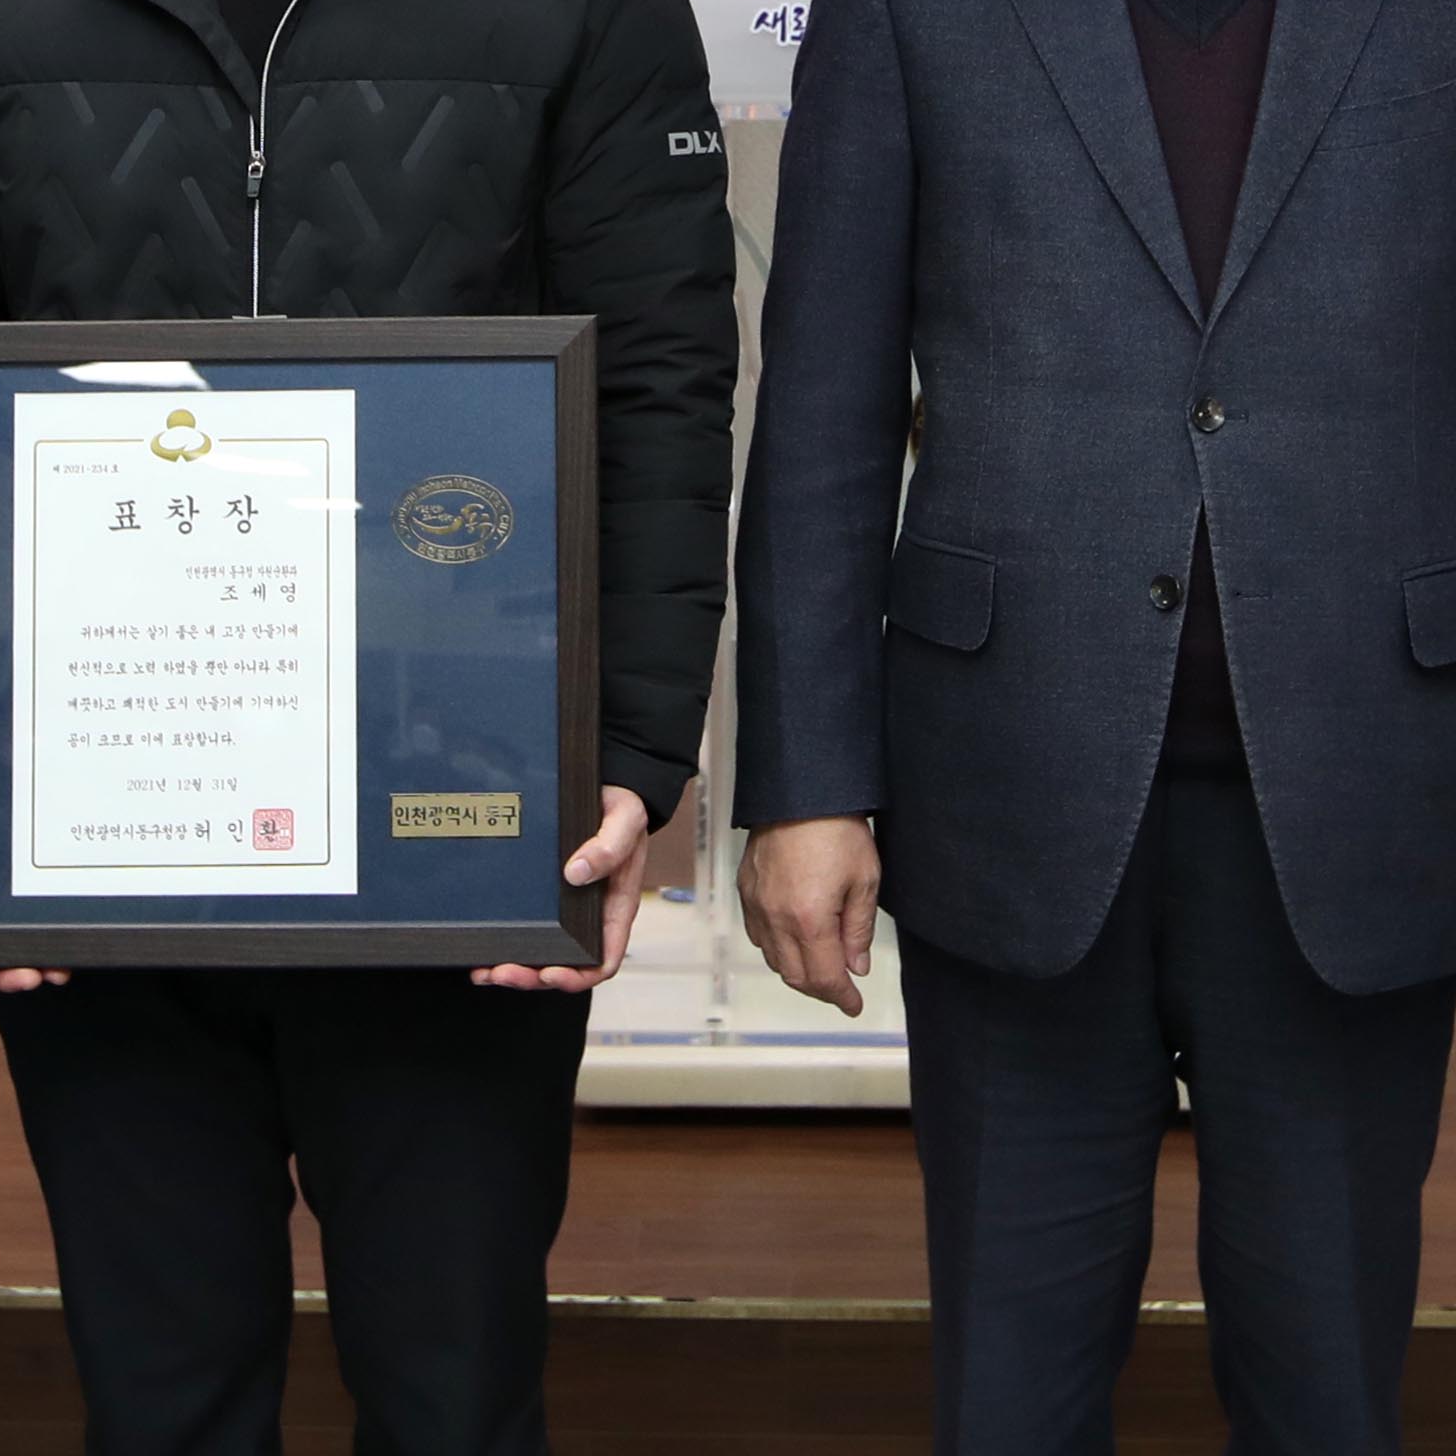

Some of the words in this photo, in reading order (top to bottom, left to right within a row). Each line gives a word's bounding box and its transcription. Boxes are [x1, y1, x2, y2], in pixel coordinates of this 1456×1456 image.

[668, 131, 723, 156] DLX
[127, 777, 167, 793] 2021년
[394, 805, 477, 827] 인천광역시
[485, 805, 517, 827] 동구
